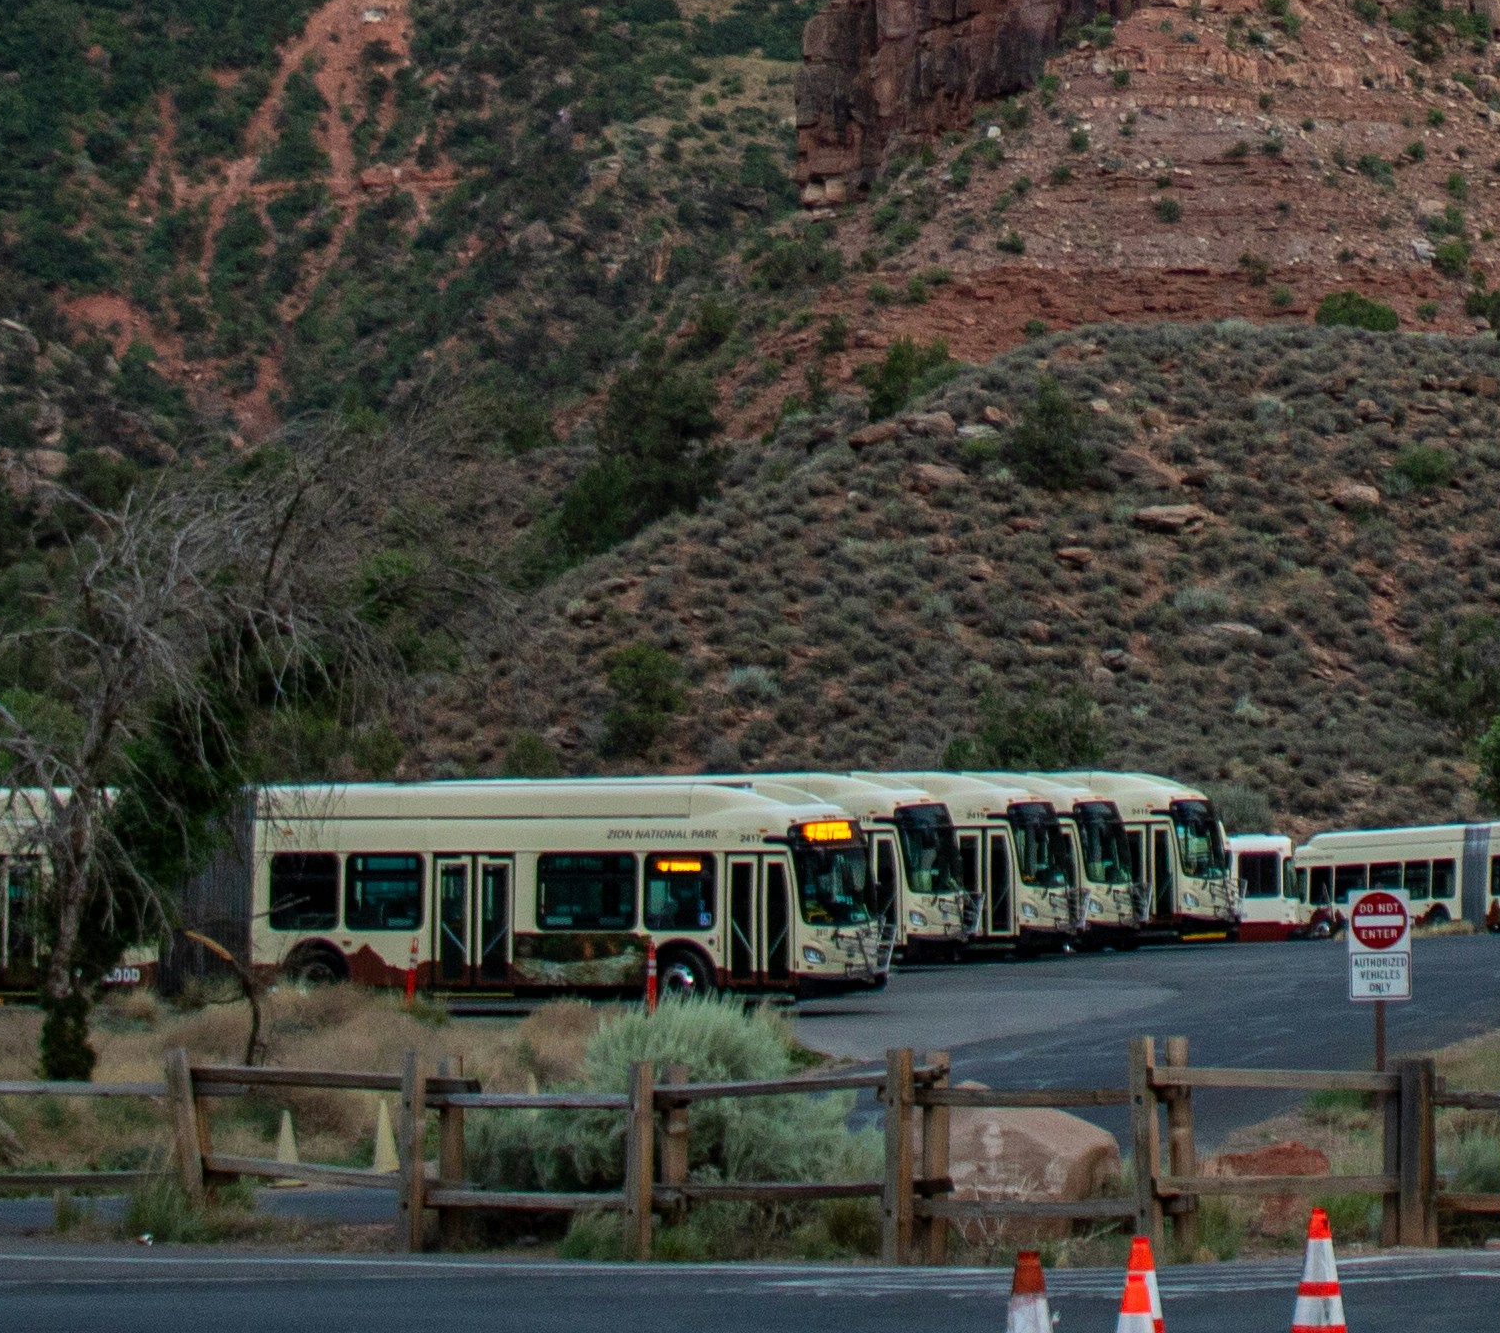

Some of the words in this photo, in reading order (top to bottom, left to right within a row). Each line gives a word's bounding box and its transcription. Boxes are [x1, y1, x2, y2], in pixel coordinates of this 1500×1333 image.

[607, 829, 633, 840] ZION
[635, 829, 688, 840] NATIONAL
[691, 829, 719, 839] PARK
[740, 834, 761, 844] 2417
[1359, 903, 1374, 914] DO
[1378, 902, 1400, 913] NOT
[1361, 928, 1398, 940] ENTER
[1354, 957, 1407, 968] AUTHORIZED
[1360, 969, 1401, 981] VEHICLES
[1369, 982, 1392, 993] ONLY
